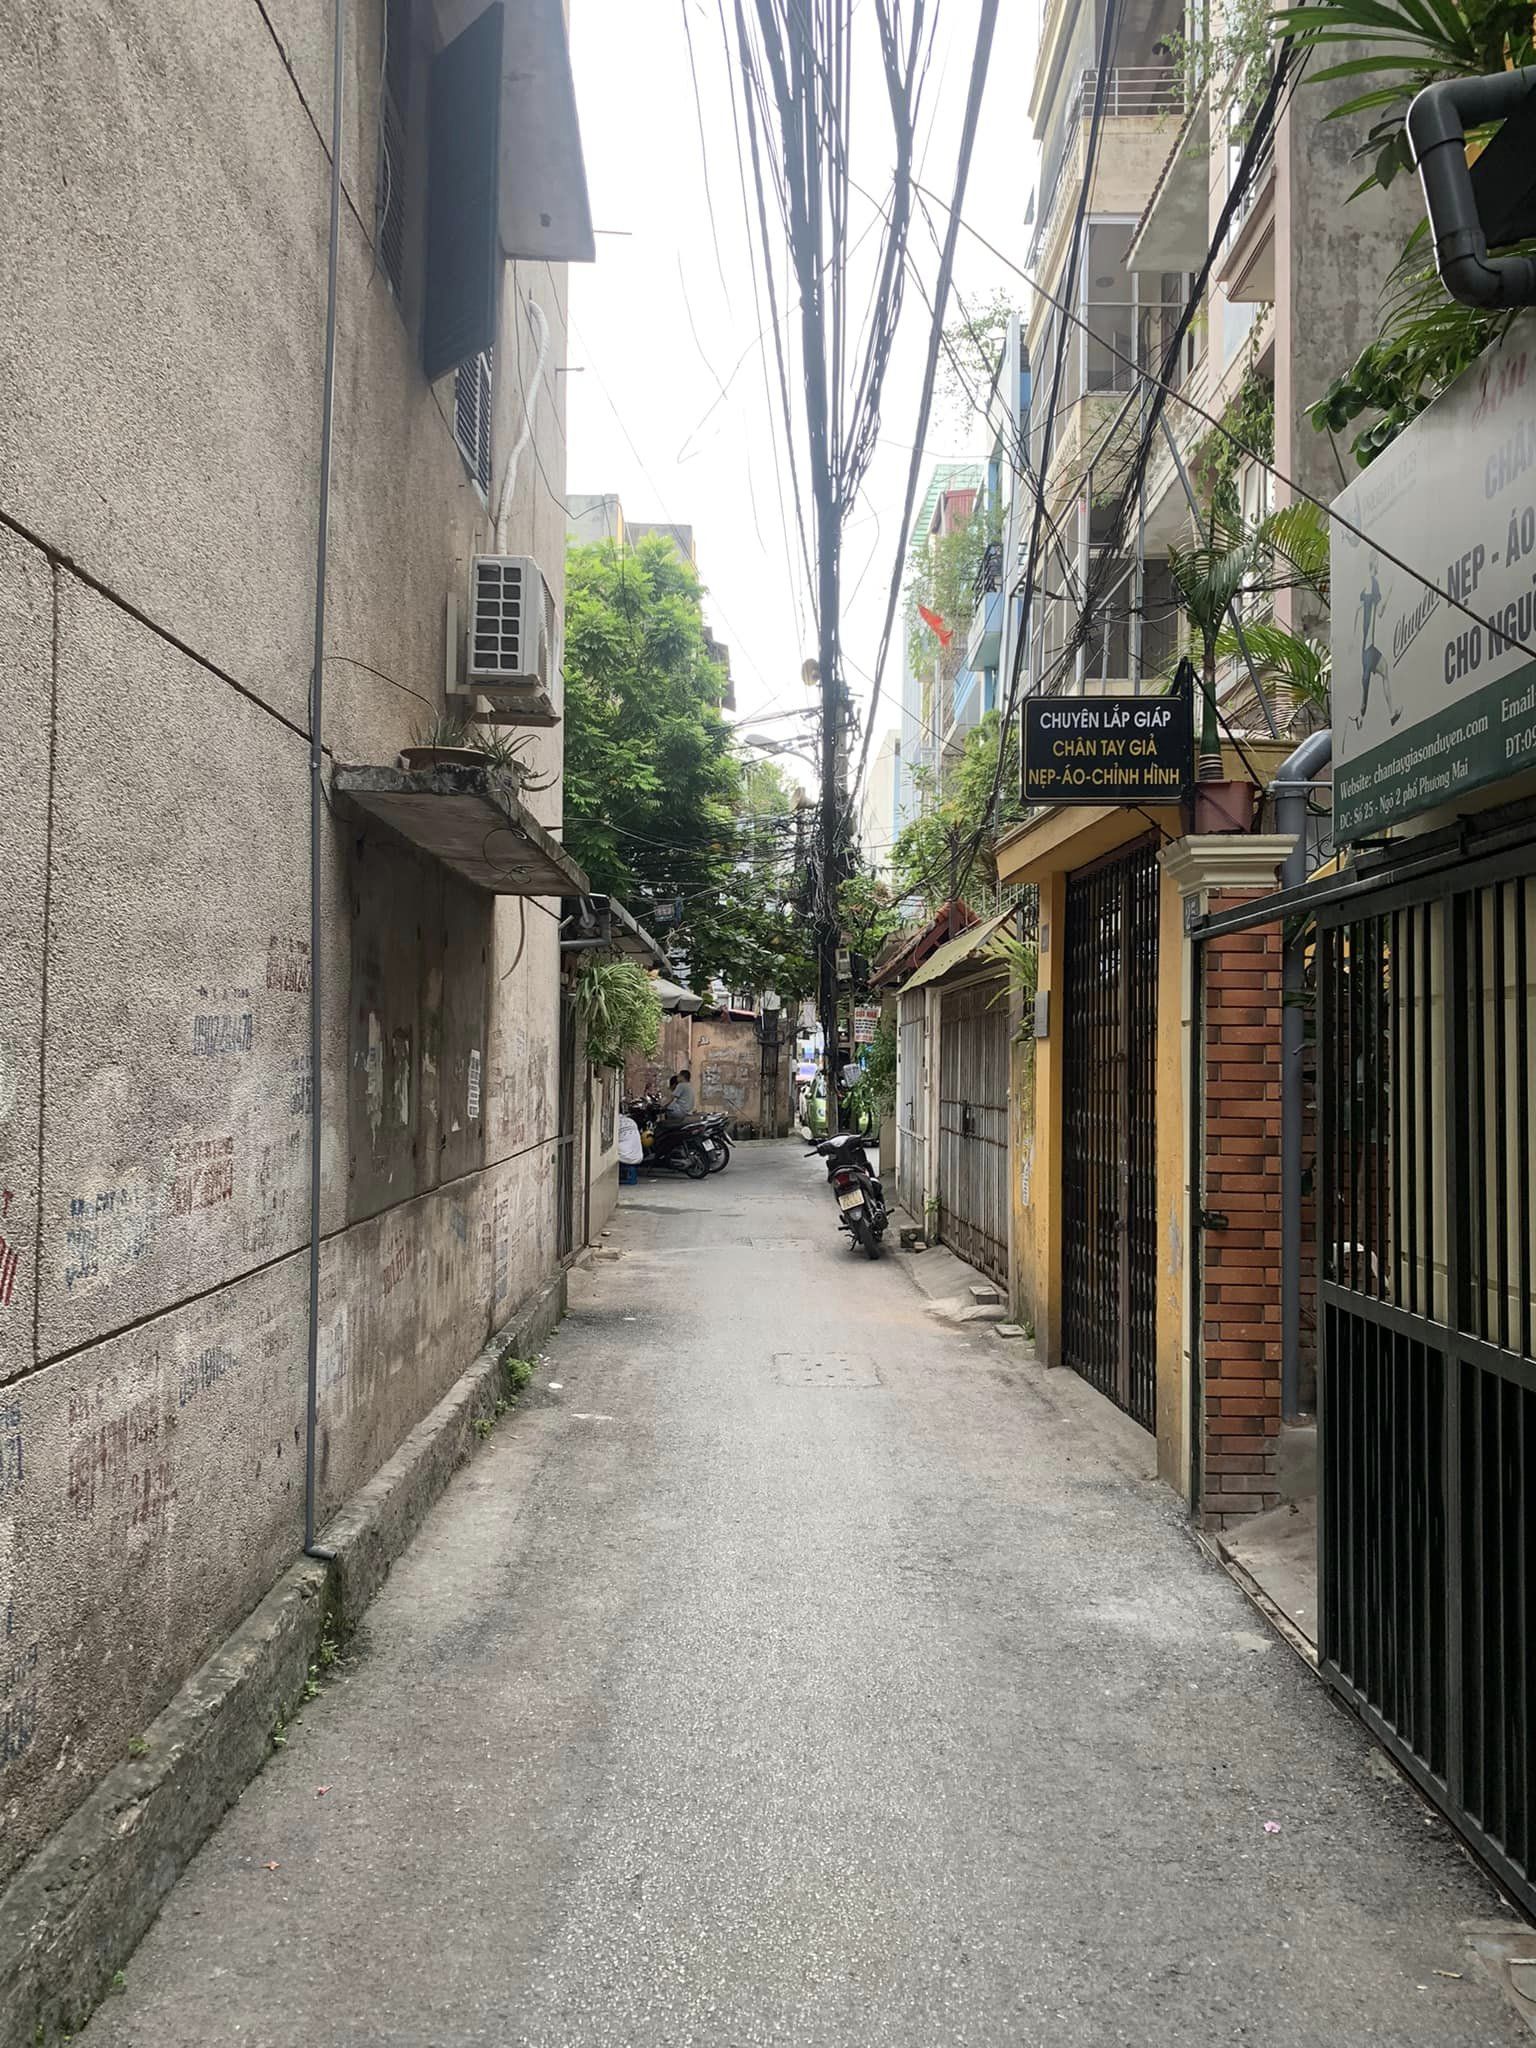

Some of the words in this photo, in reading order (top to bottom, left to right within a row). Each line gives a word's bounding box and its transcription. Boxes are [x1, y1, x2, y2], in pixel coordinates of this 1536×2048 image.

[1448, 543, 1485, 608] NẸP
[1506, 506, 1535, 568] ÁO
[1444, 625, 1482, 685] CHO
[1040, 709, 1100, 729] CHUYÊN
[1104, 704, 1130, 728] LẮP
[1134, 706, 1171, 728] GIÁP
[1053, 736, 1097, 757] CHÂN
[1100, 739, 1126, 756] TAY
[1129, 733, 1158, 756] GIẢ
[1028, 762, 1139, 789] NẸP-ÁO-CHỈNH
[1143, 762, 1180, 785] HÌNH
[1340, 774, 1372, 800] Website:
[1373, 715, 1489, 784] chantaygiasonduyen.com
[1364, 801, 1374, 820] 25
[1395, 788, 1401, 806] 2
[1452, 757, 1469, 779] Mai
